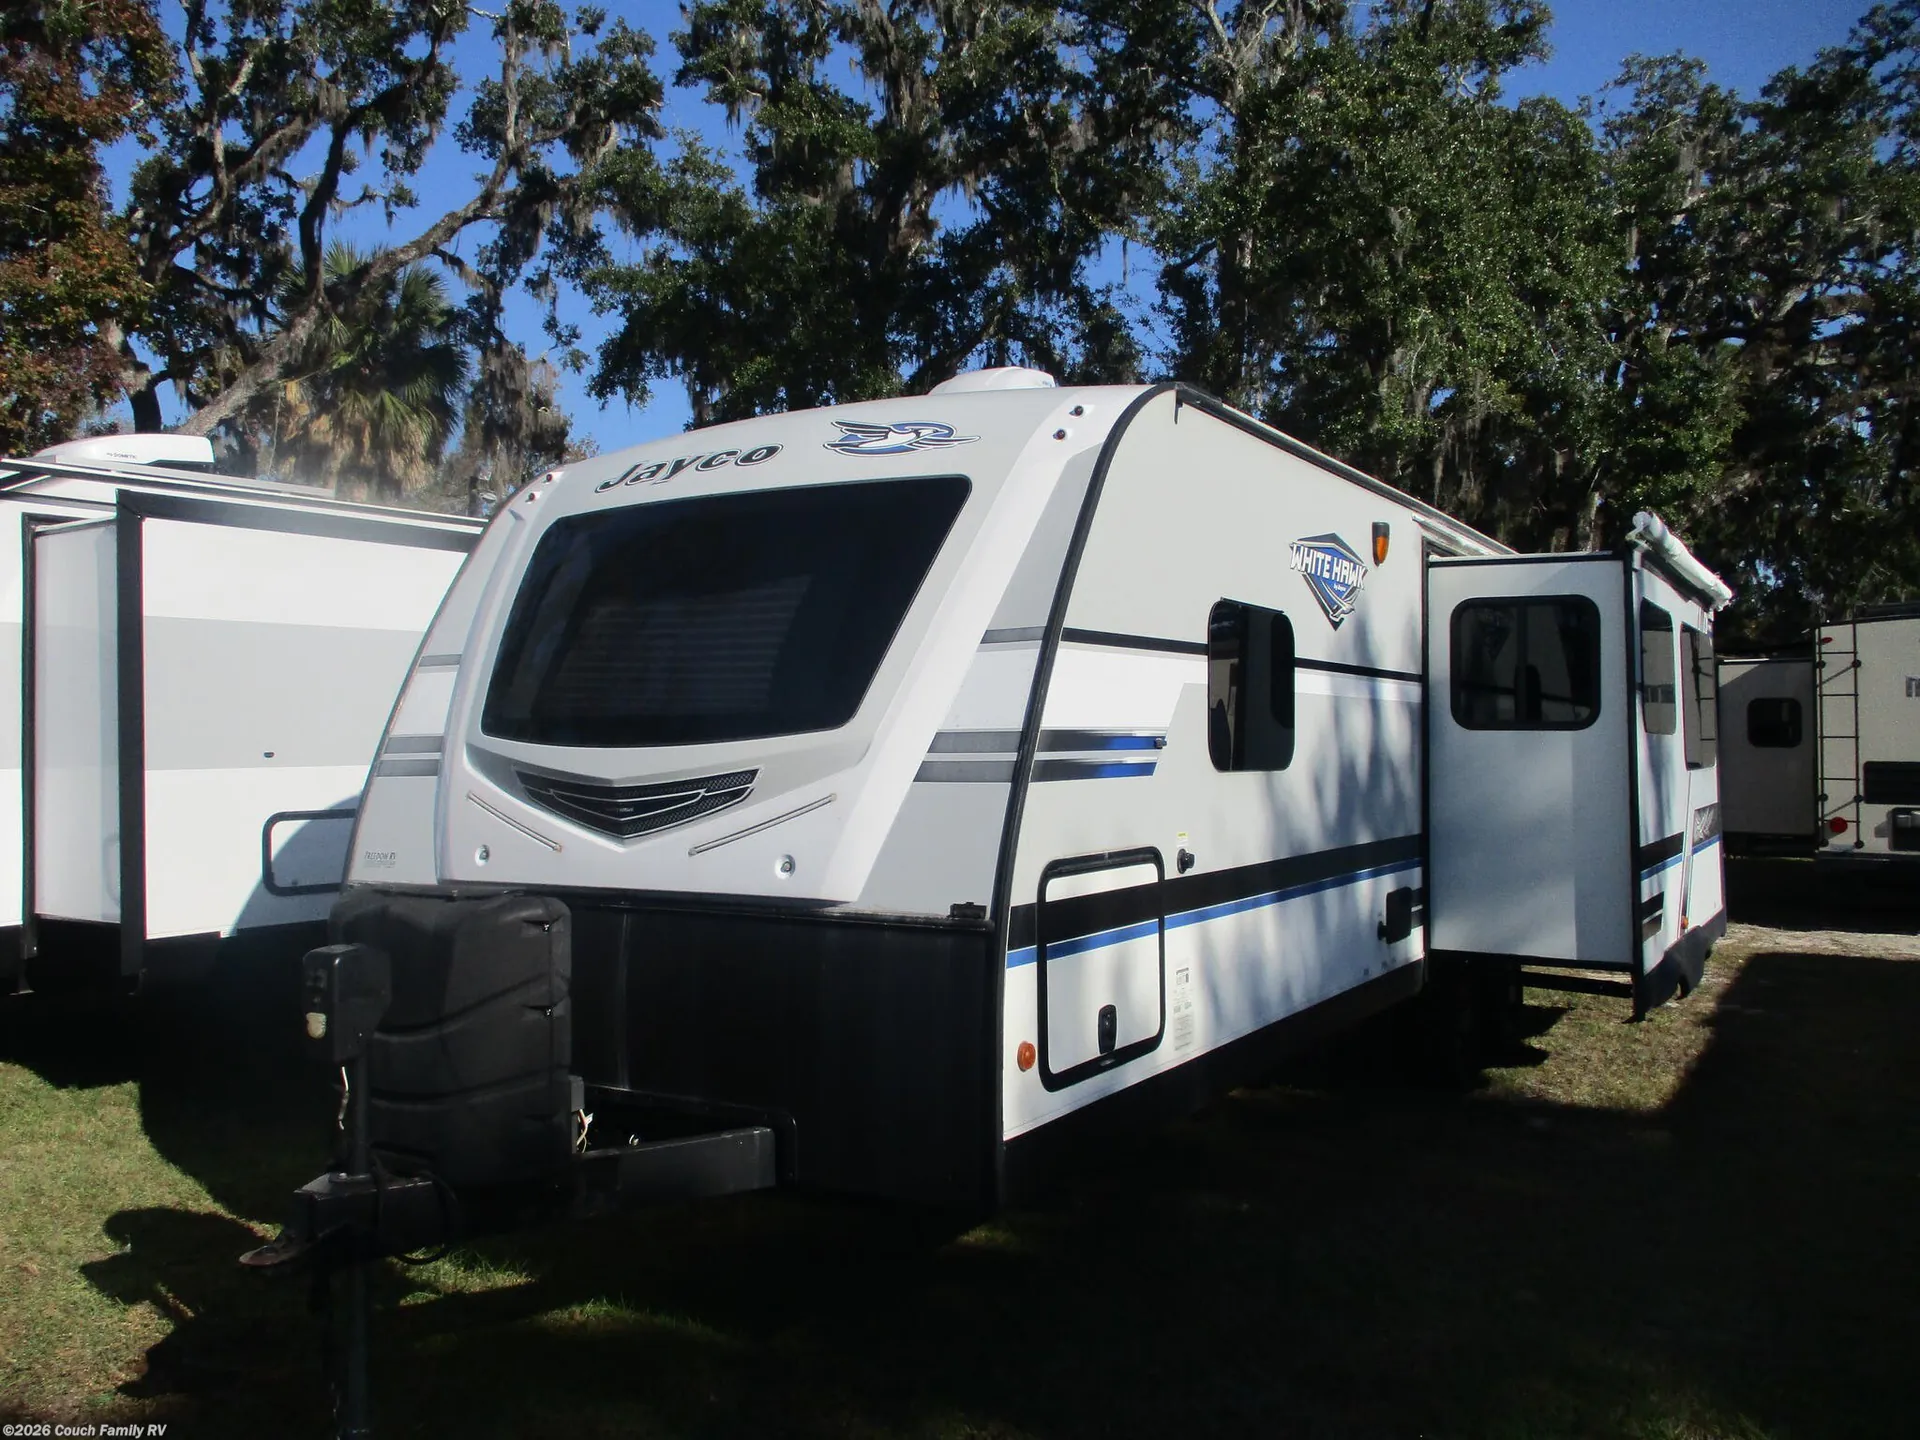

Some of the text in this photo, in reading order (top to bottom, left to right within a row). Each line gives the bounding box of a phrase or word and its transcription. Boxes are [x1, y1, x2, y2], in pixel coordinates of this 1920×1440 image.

[595, 443, 784, 495] Jayco
[1289, 542, 1366, 590] WHITE HAWK
